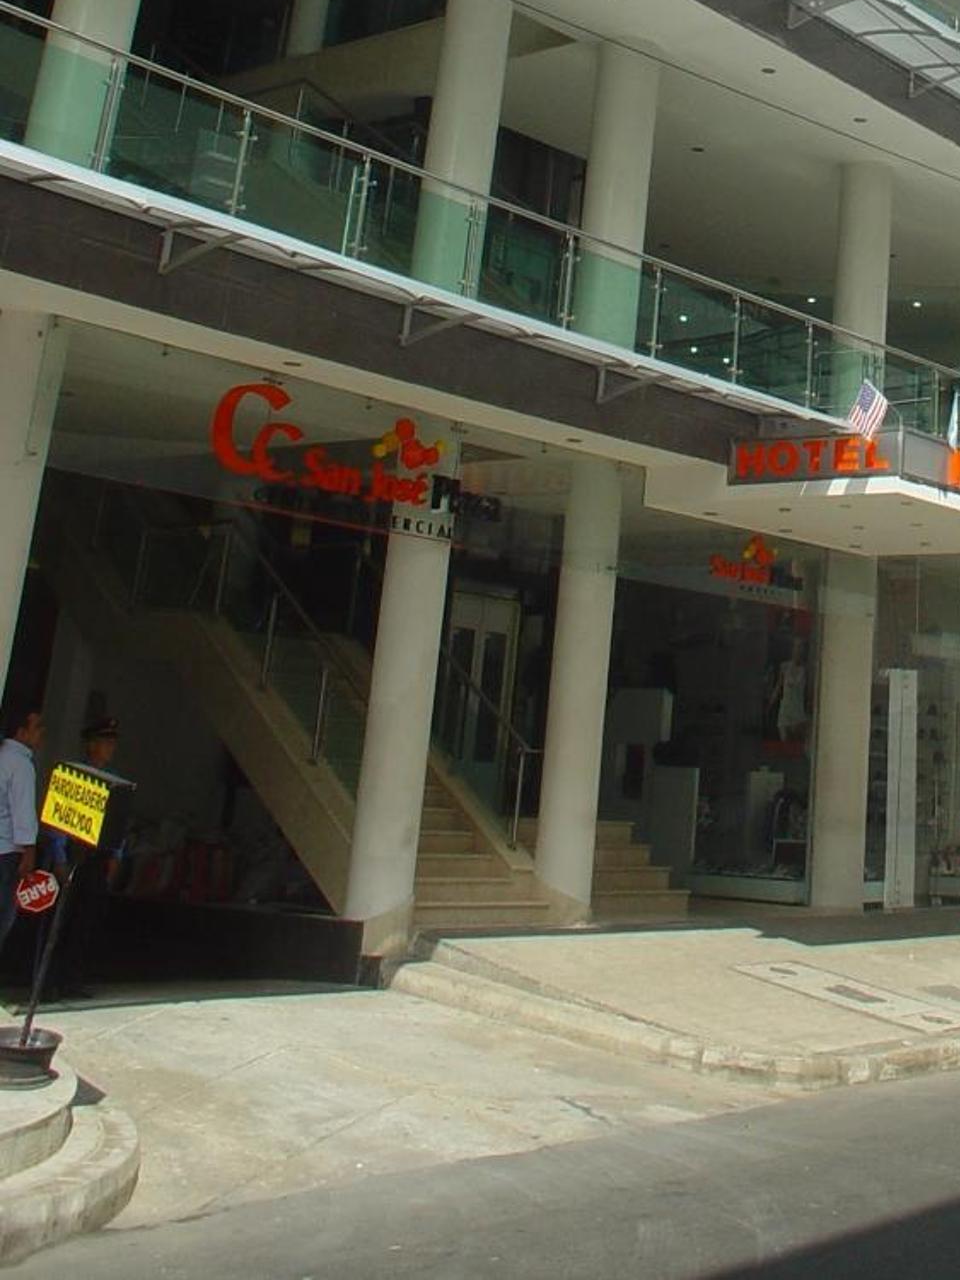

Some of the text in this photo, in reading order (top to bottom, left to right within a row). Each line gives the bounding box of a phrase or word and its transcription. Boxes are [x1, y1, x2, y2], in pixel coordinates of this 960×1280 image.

[300, 445, 362, 496] San
[736, 437, 891, 479] HOTEL
[18, 877, 56, 907] PARE
